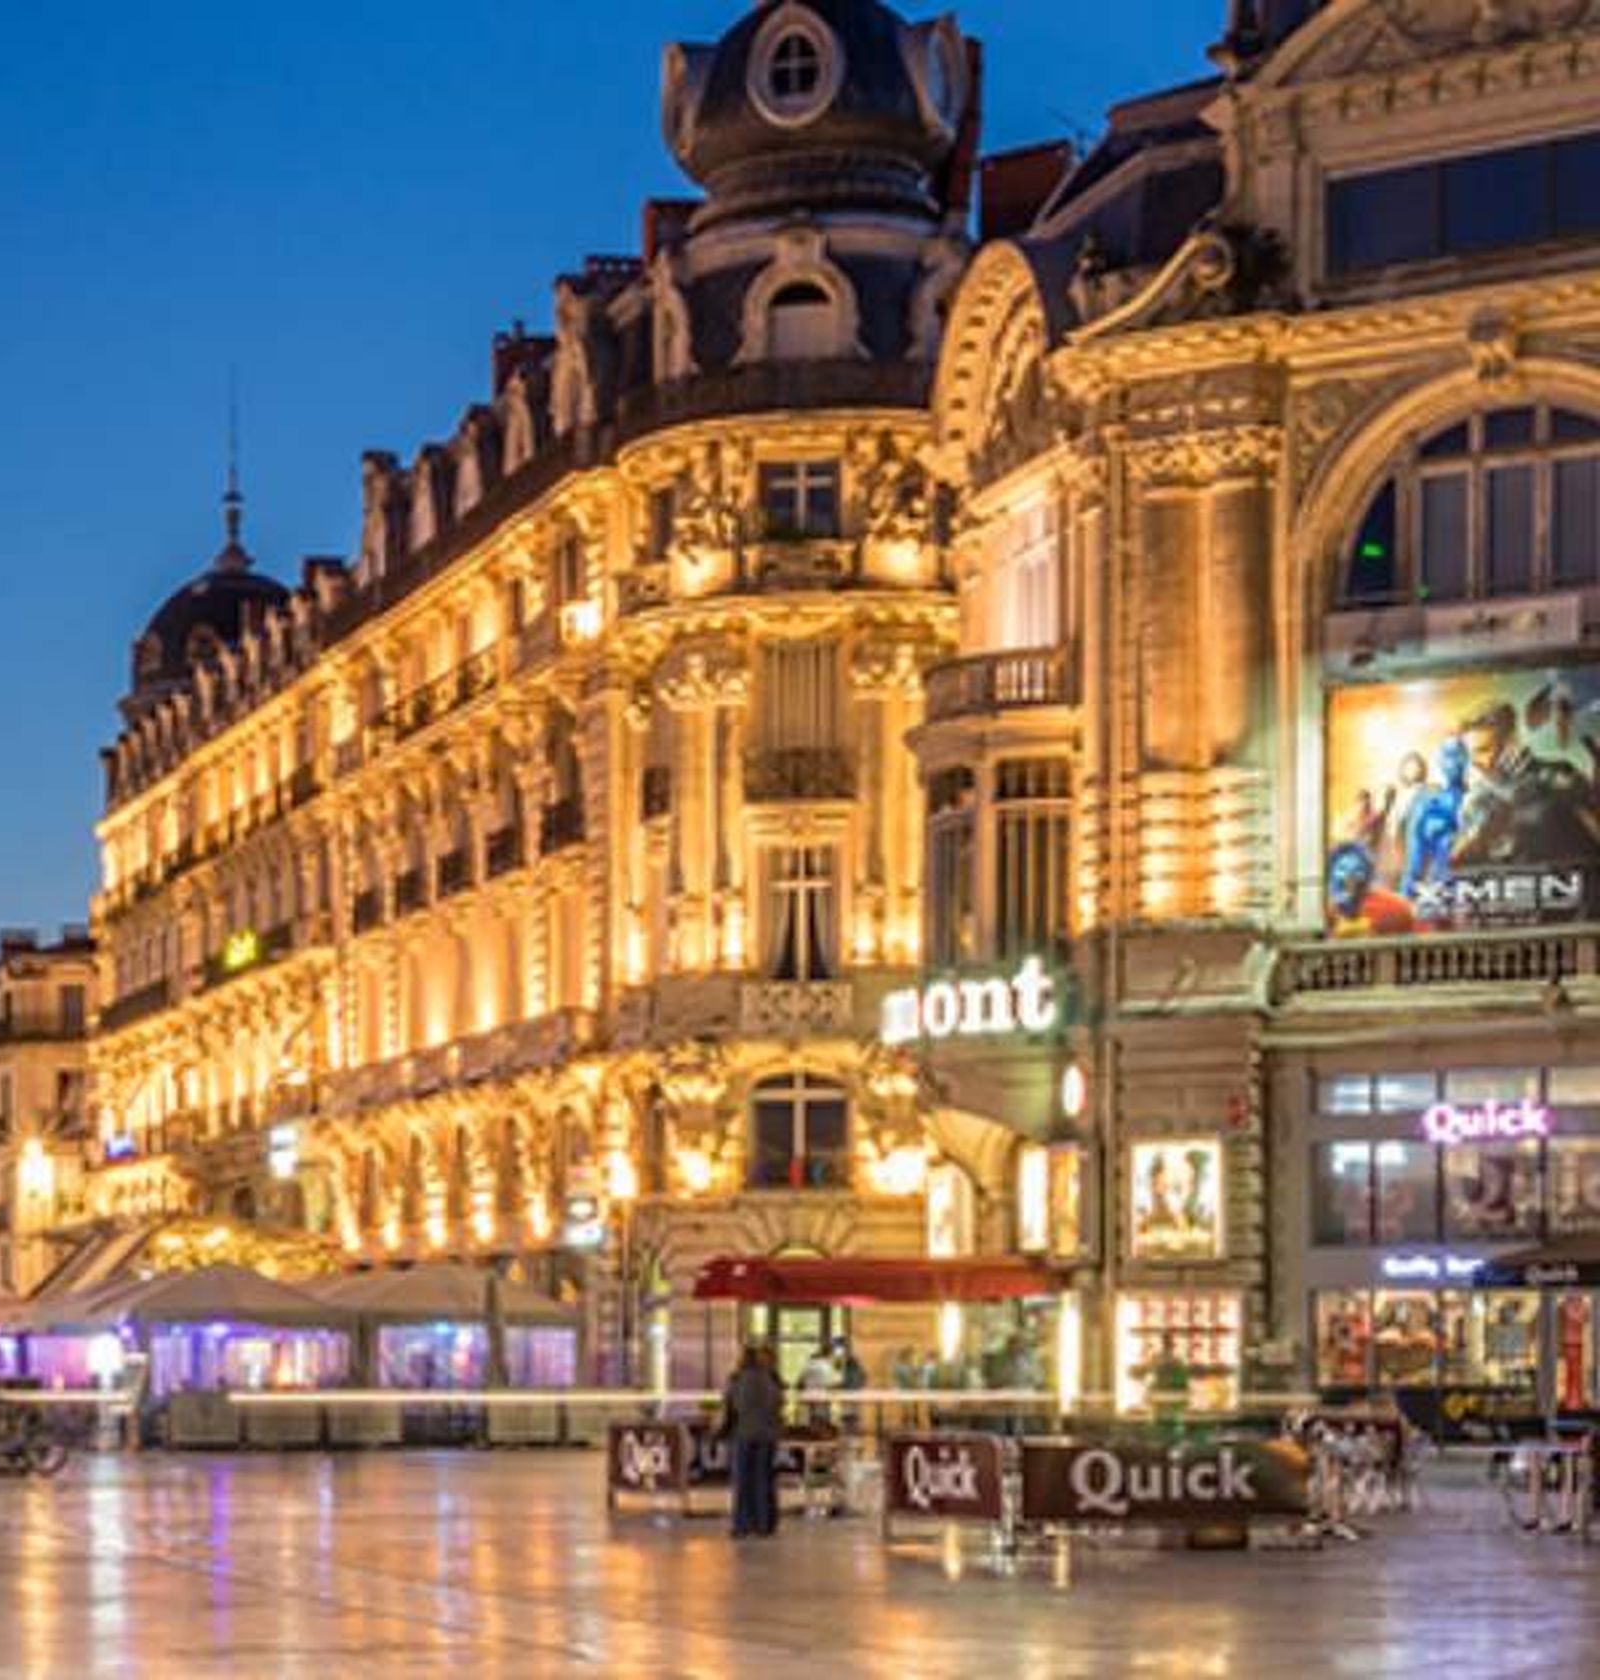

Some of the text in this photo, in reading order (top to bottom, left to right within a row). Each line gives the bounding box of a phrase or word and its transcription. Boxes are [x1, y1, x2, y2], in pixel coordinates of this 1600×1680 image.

[1423, 1100, 1548, 1145] Quick
[904, 1445, 979, 1508] Quick
[1070, 1444, 1256, 1514] Quick
